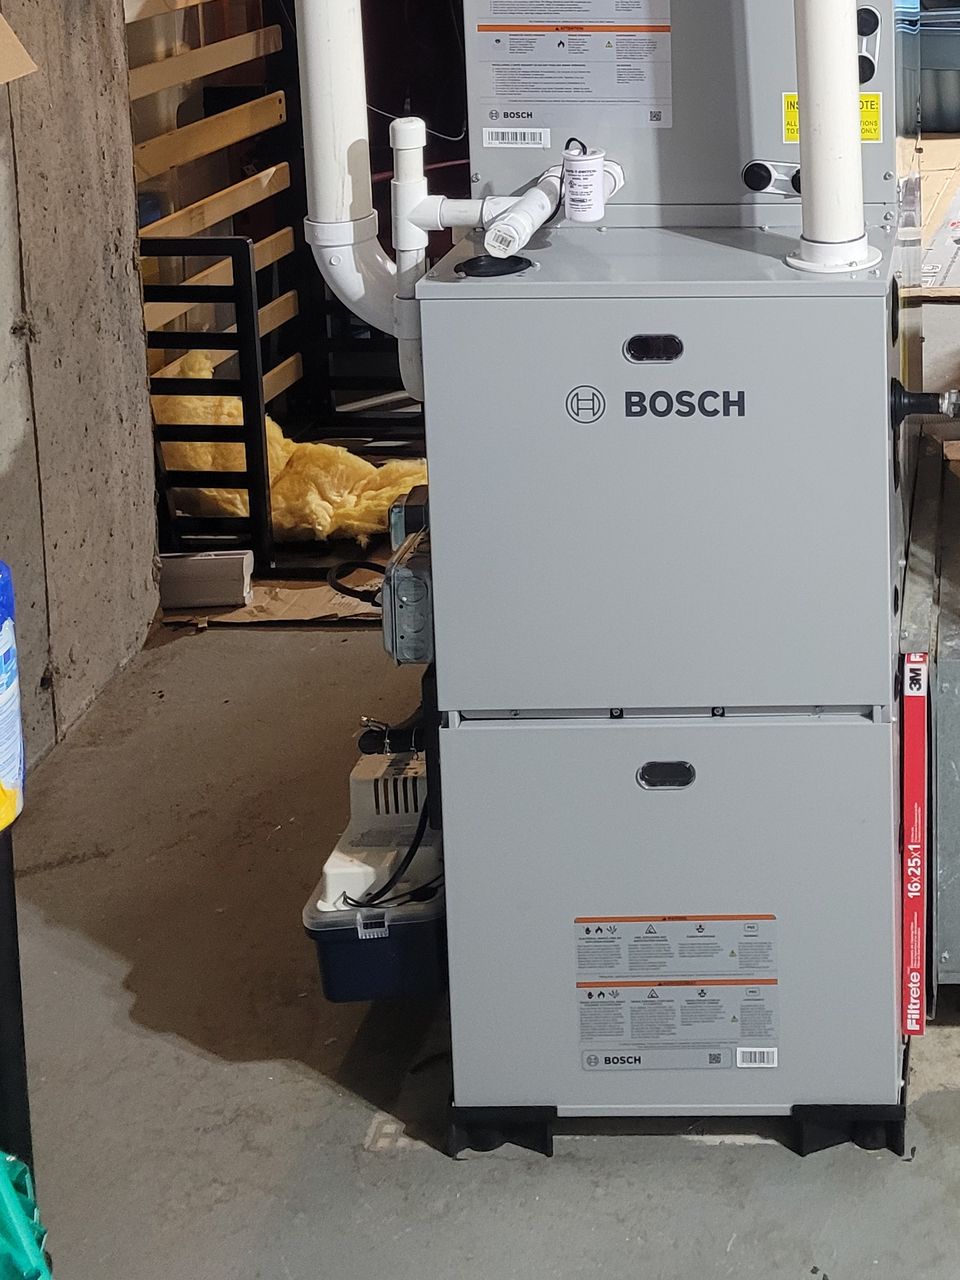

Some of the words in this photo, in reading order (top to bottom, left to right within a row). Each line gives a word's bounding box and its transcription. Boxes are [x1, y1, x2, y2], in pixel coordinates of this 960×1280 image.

[859, 100, 879, 110] OTE:
[503, 111, 533, 119] BOSCH
[625, 390, 746, 418] BOSCH
[909, 668, 922, 691] 3M
[907, 971, 921, 1031] Filtrete
[604, 1056, 642, 1065] BOSCH
